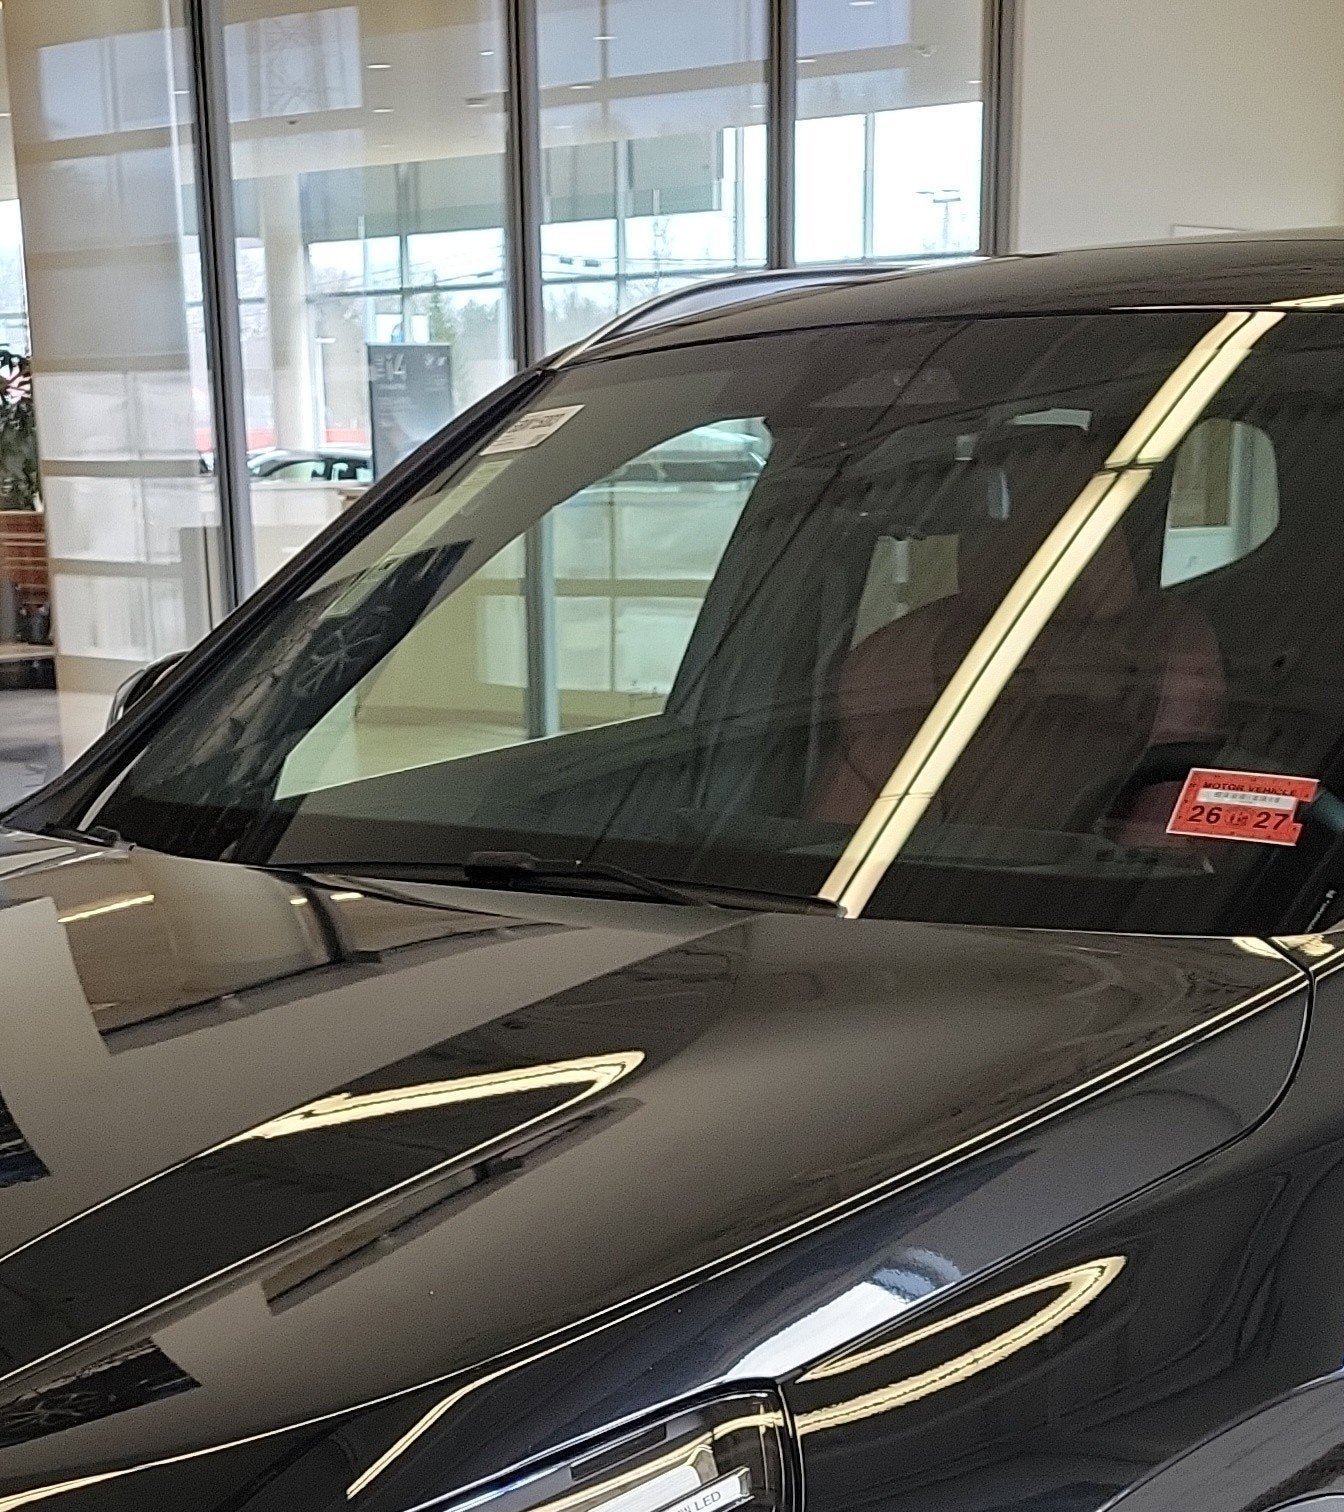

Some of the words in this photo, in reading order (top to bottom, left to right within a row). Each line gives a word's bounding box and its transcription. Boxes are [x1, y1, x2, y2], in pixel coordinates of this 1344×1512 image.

[1202, 781, 1245, 791] MOTOR
[1248, 785, 1298, 797] VEHICLE
[1187, 805, 1223, 825] 26
[1252, 811, 1291, 831] 27
[694, 1491, 721, 1511] LED
